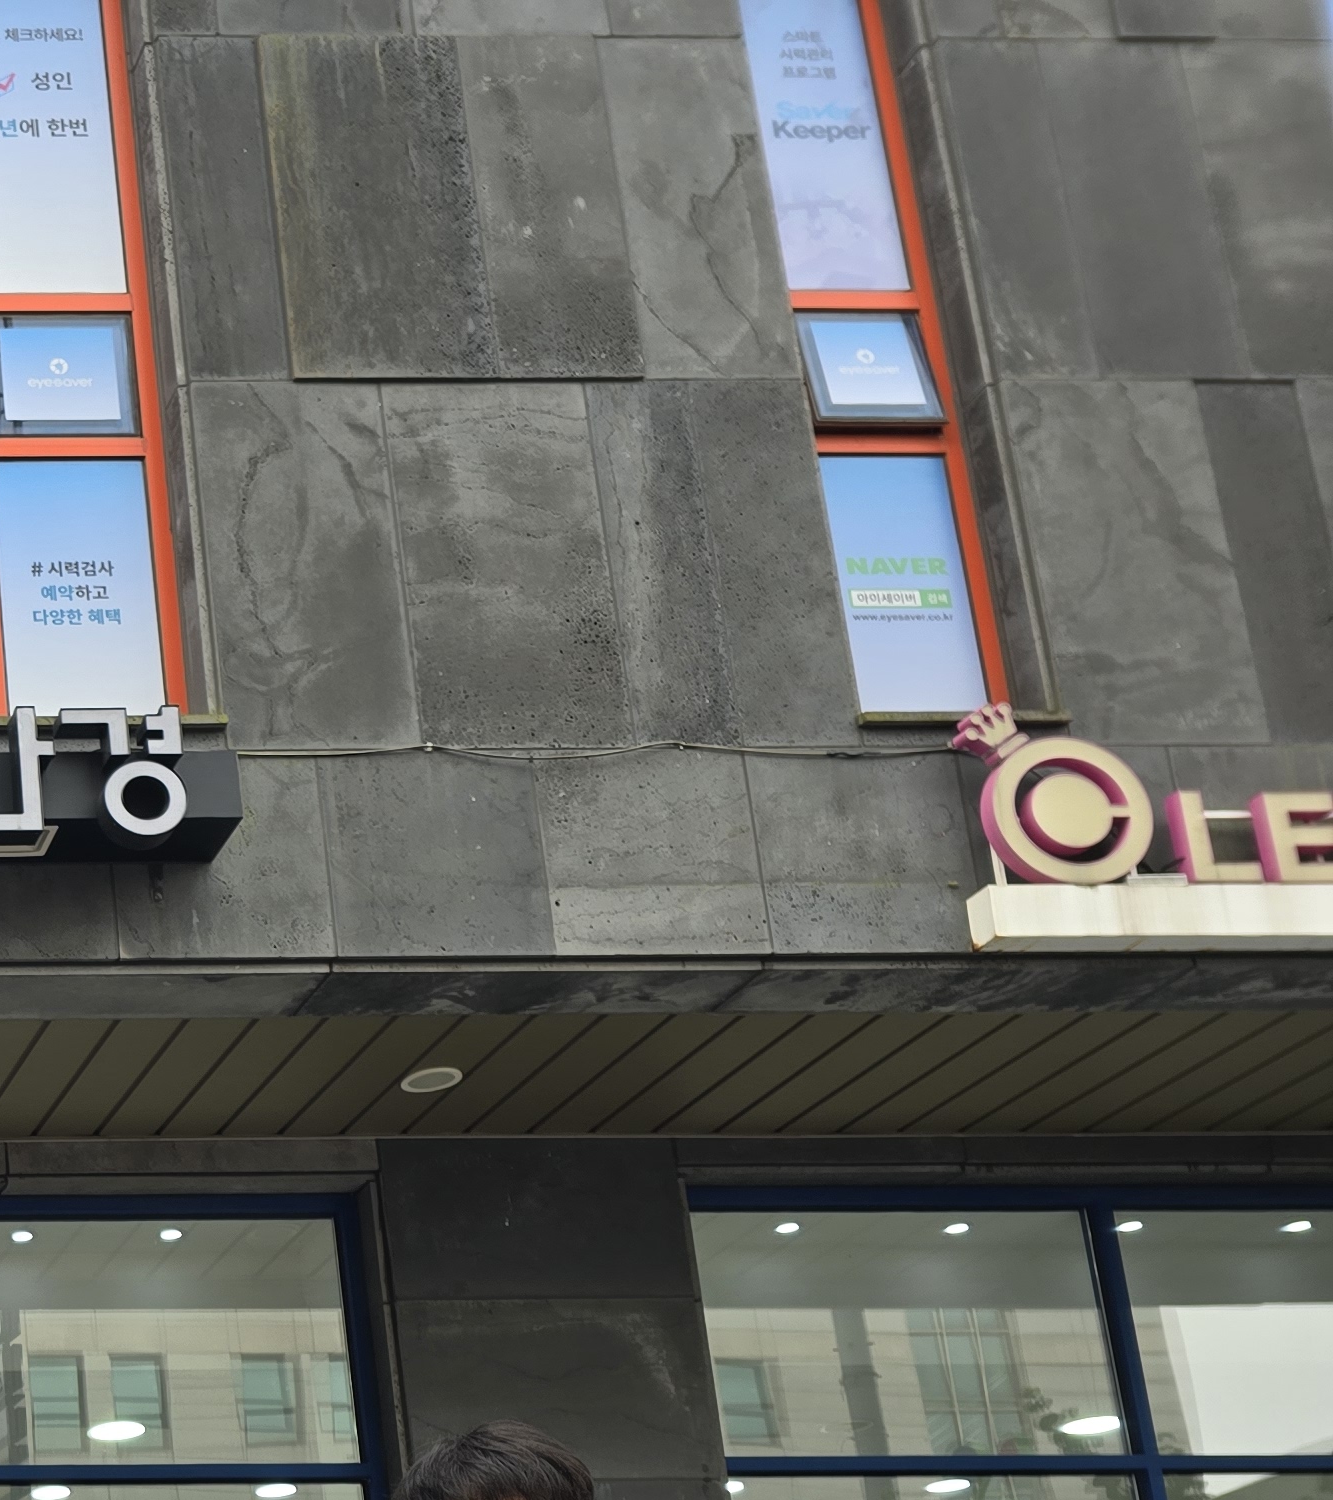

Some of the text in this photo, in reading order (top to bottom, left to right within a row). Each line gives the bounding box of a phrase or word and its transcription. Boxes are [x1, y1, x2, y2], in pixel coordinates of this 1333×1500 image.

[5, 28, 83, 43] 체크하세요!
[31, 72, 73, 91] 성인
[47, 119, 89, 138] 한번
[772, 120, 871, 143] Keeper
[27, 376, 93, 389] eyesaver
[48, 560, 115, 577] 시력검사
[845, 557, 949, 575] NAVER
[41, 585, 110, 601] 예약하고
[33, 608, 122, 626] 다양한 혜택
